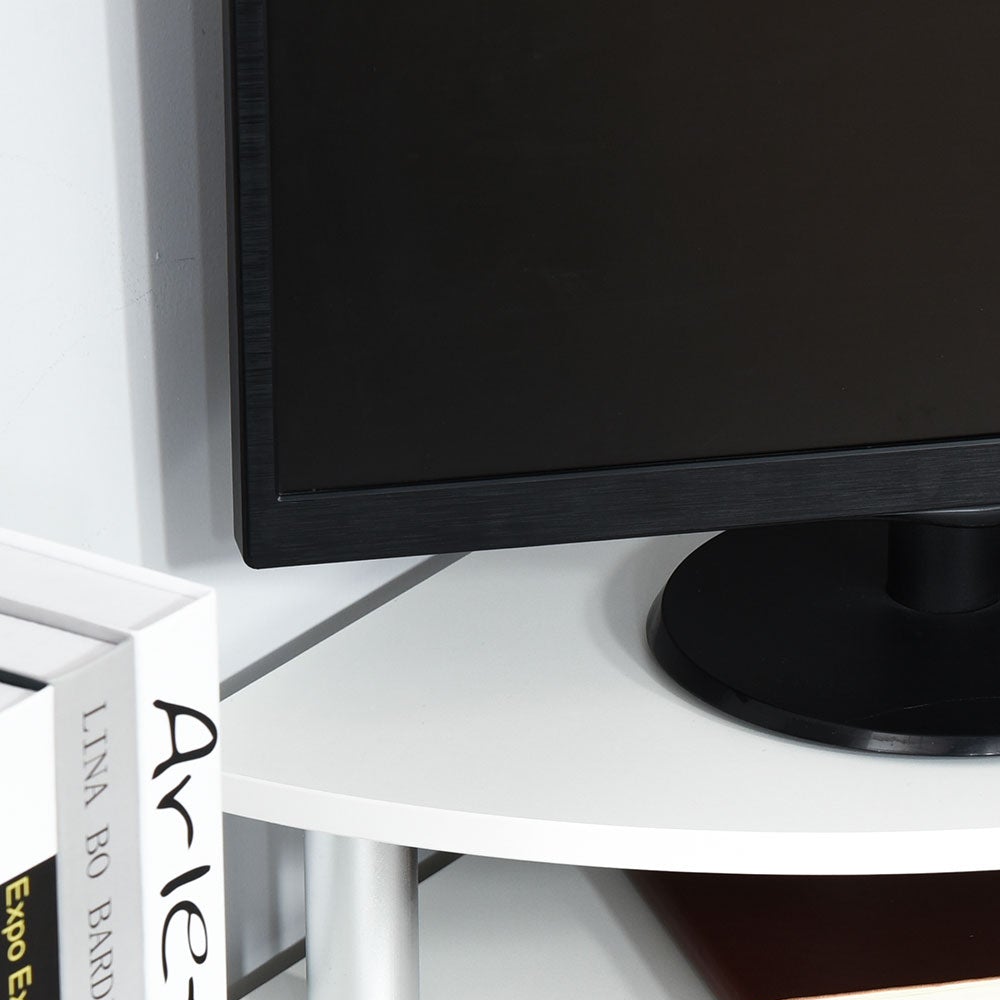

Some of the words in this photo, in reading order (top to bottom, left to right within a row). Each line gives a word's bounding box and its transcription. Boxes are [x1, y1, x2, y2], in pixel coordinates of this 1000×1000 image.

[82, 702, 107, 807] LINA
[85, 824, 110, 879] BO
[1, 876, 30, 962] Expo
